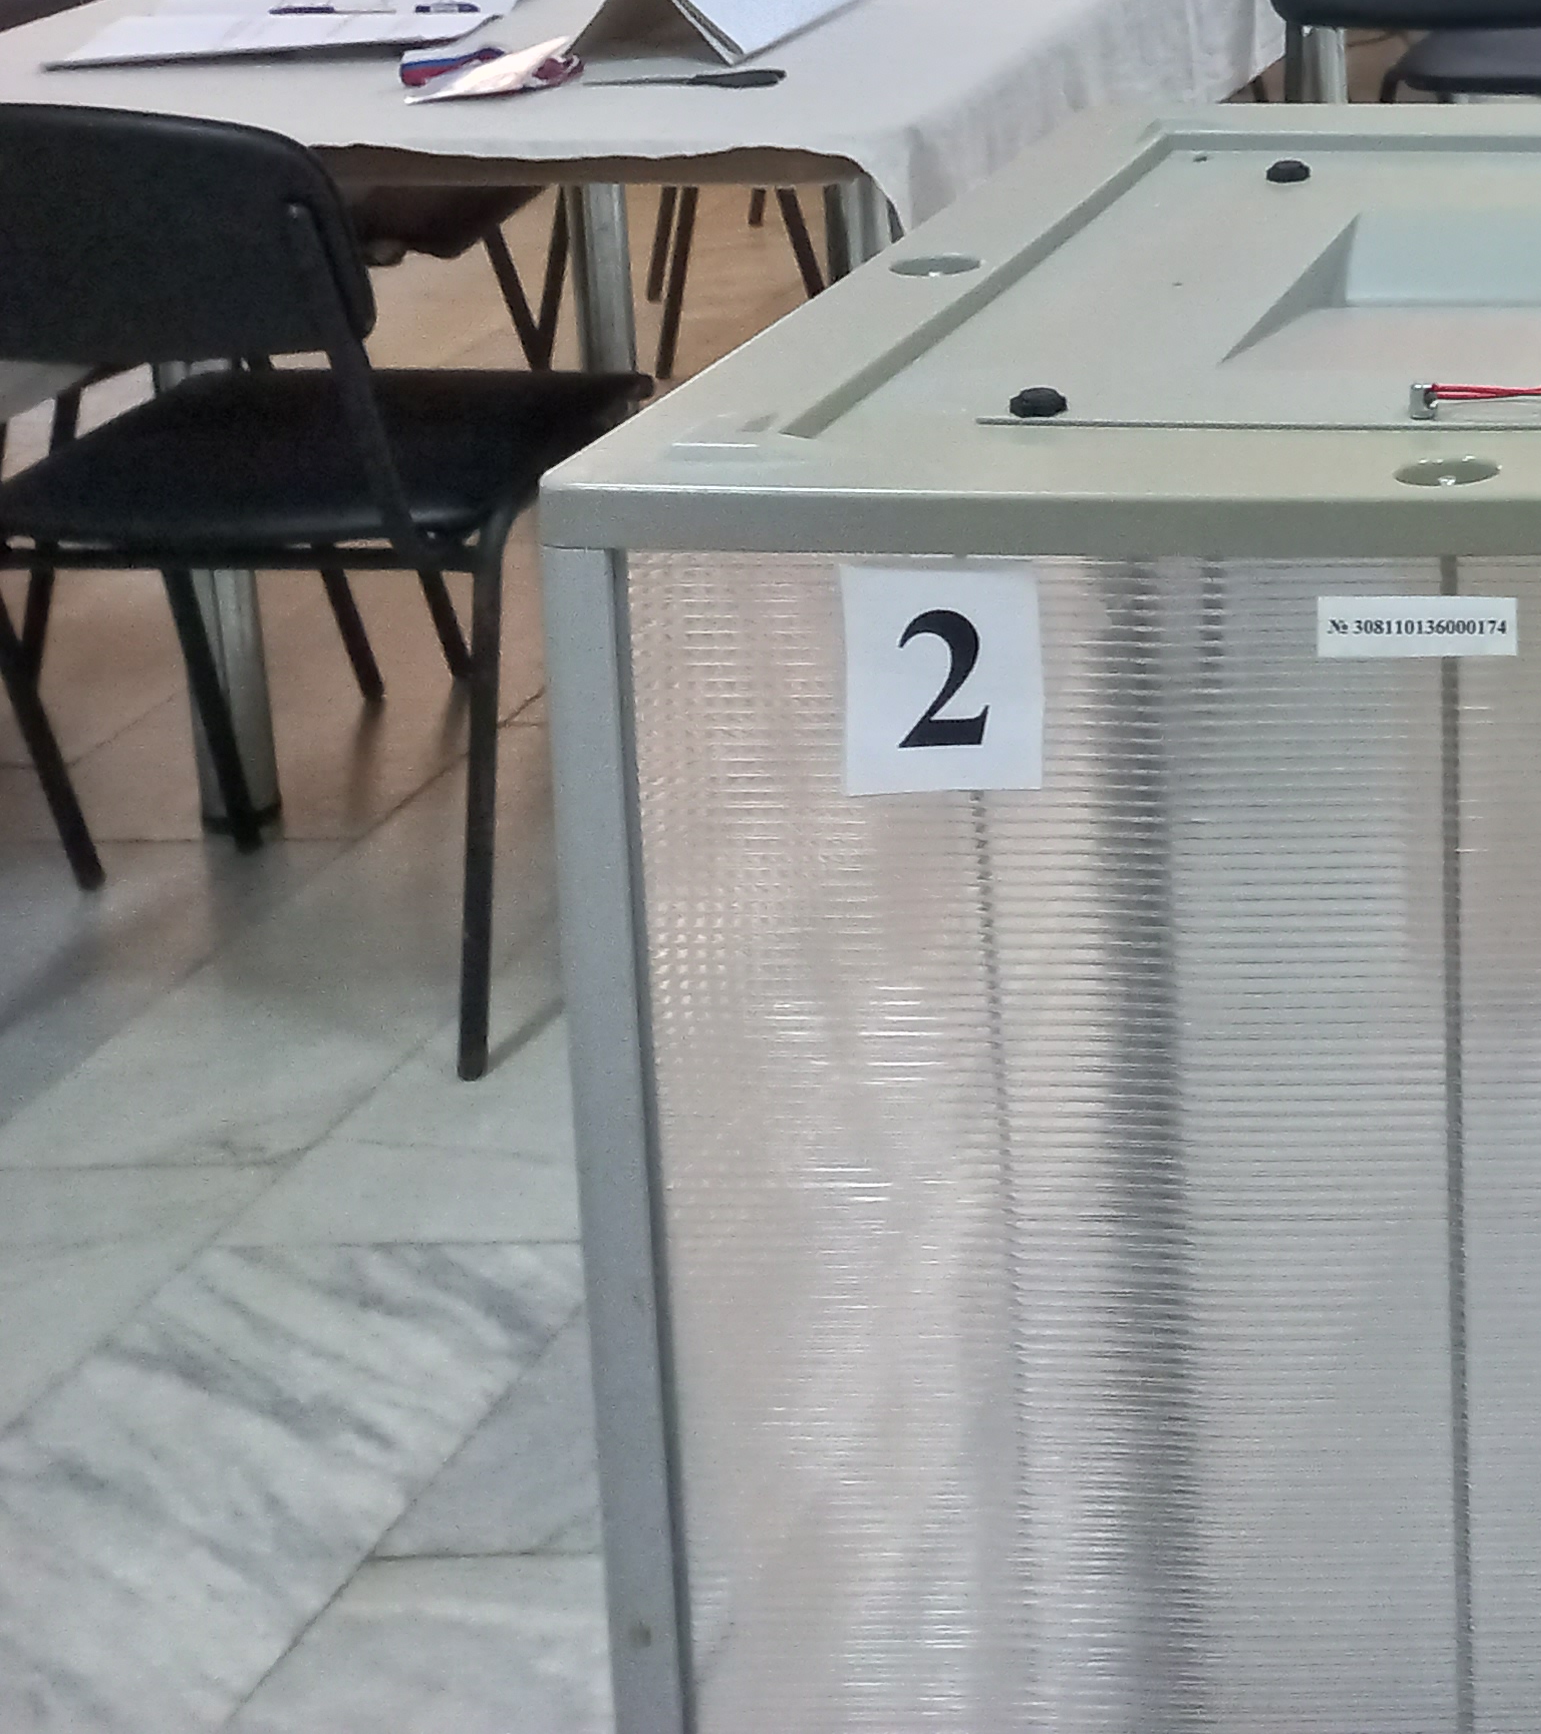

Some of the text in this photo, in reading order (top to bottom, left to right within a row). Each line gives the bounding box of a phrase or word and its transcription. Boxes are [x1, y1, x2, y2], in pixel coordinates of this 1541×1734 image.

[1327, 619, 1508, 635] № 308110136000174
[897, 608, 990, 749] 2
